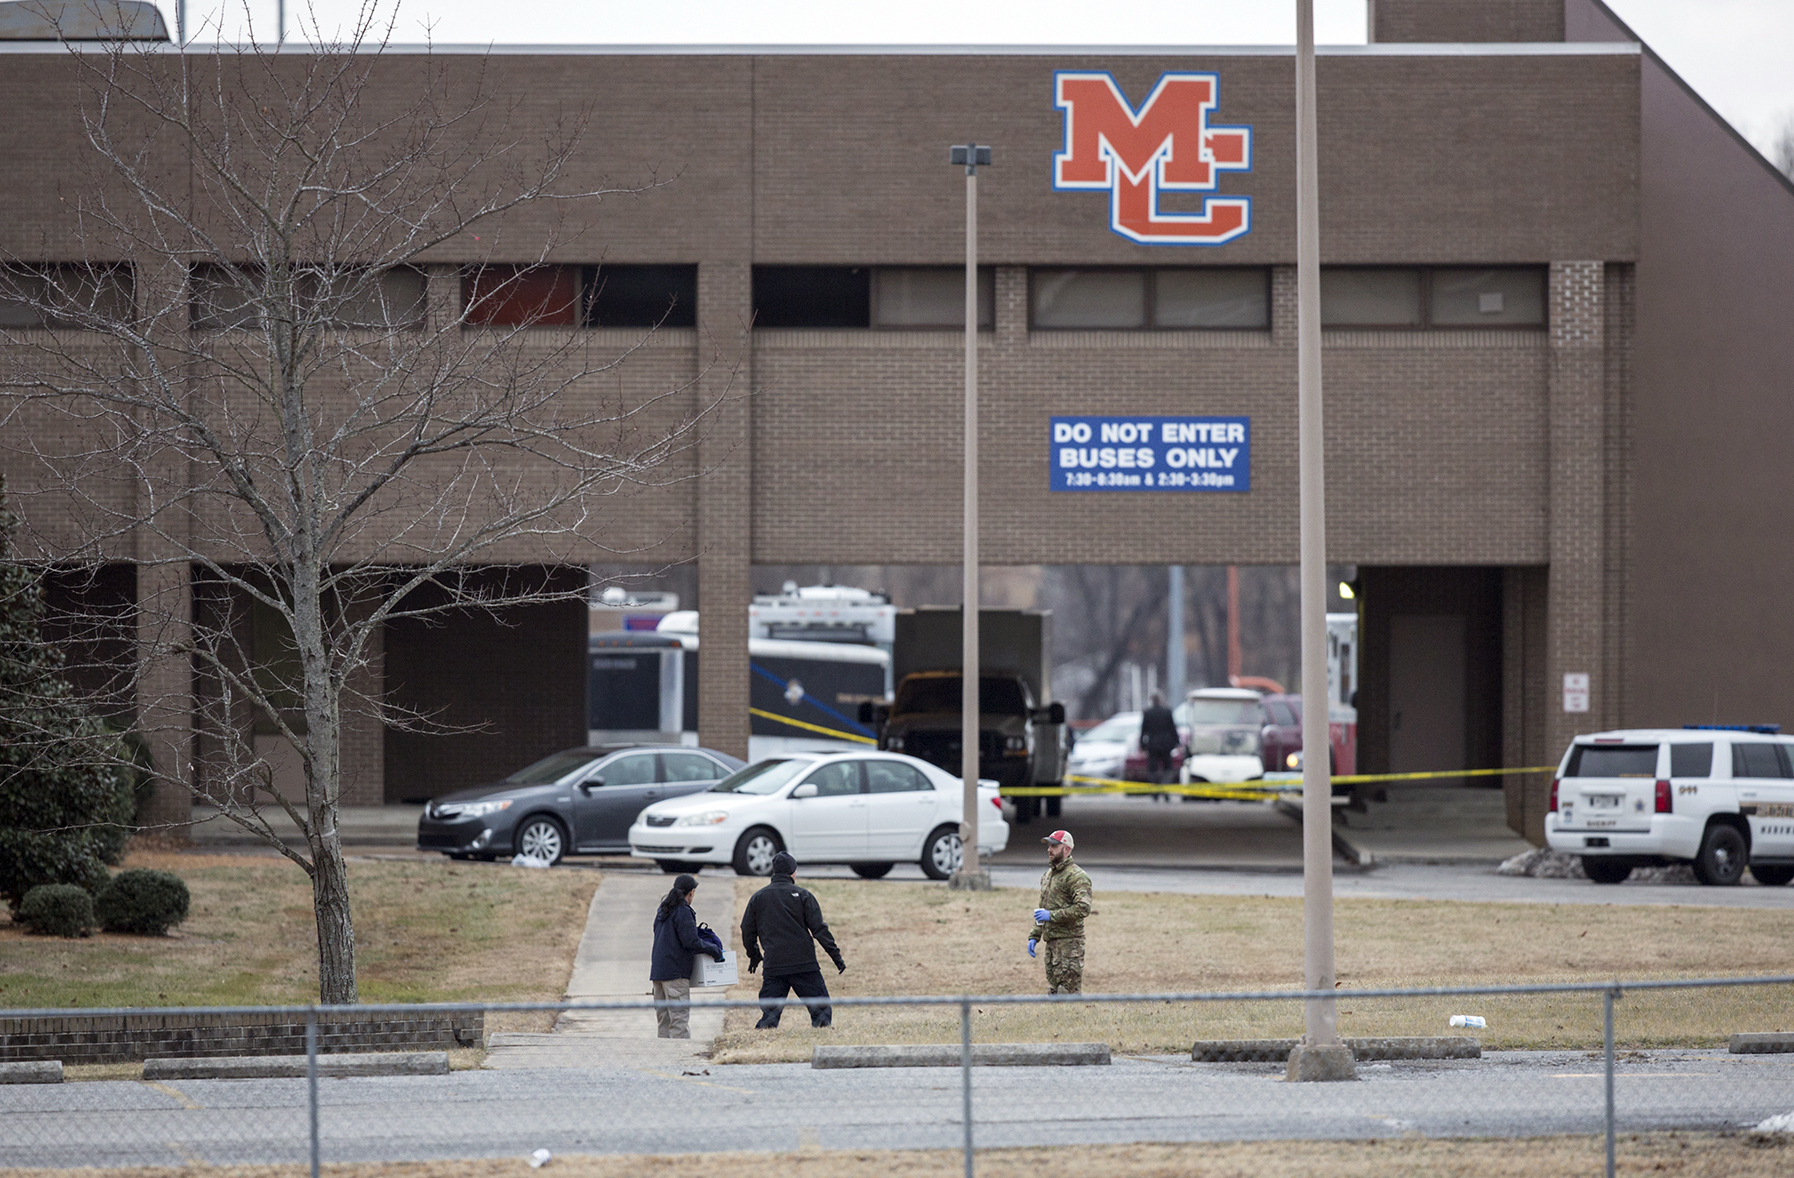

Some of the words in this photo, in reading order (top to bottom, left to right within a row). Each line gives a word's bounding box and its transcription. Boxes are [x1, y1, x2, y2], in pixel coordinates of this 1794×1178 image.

[1054, 423, 1092, 443] DO
[1101, 423, 1153, 443] NOT
[1161, 423, 1245, 443] ENTER
[1059, 448, 1155, 468] BUSES
[1165, 448, 1239, 468] ONLY
[1144, 472, 1154, 487] &
